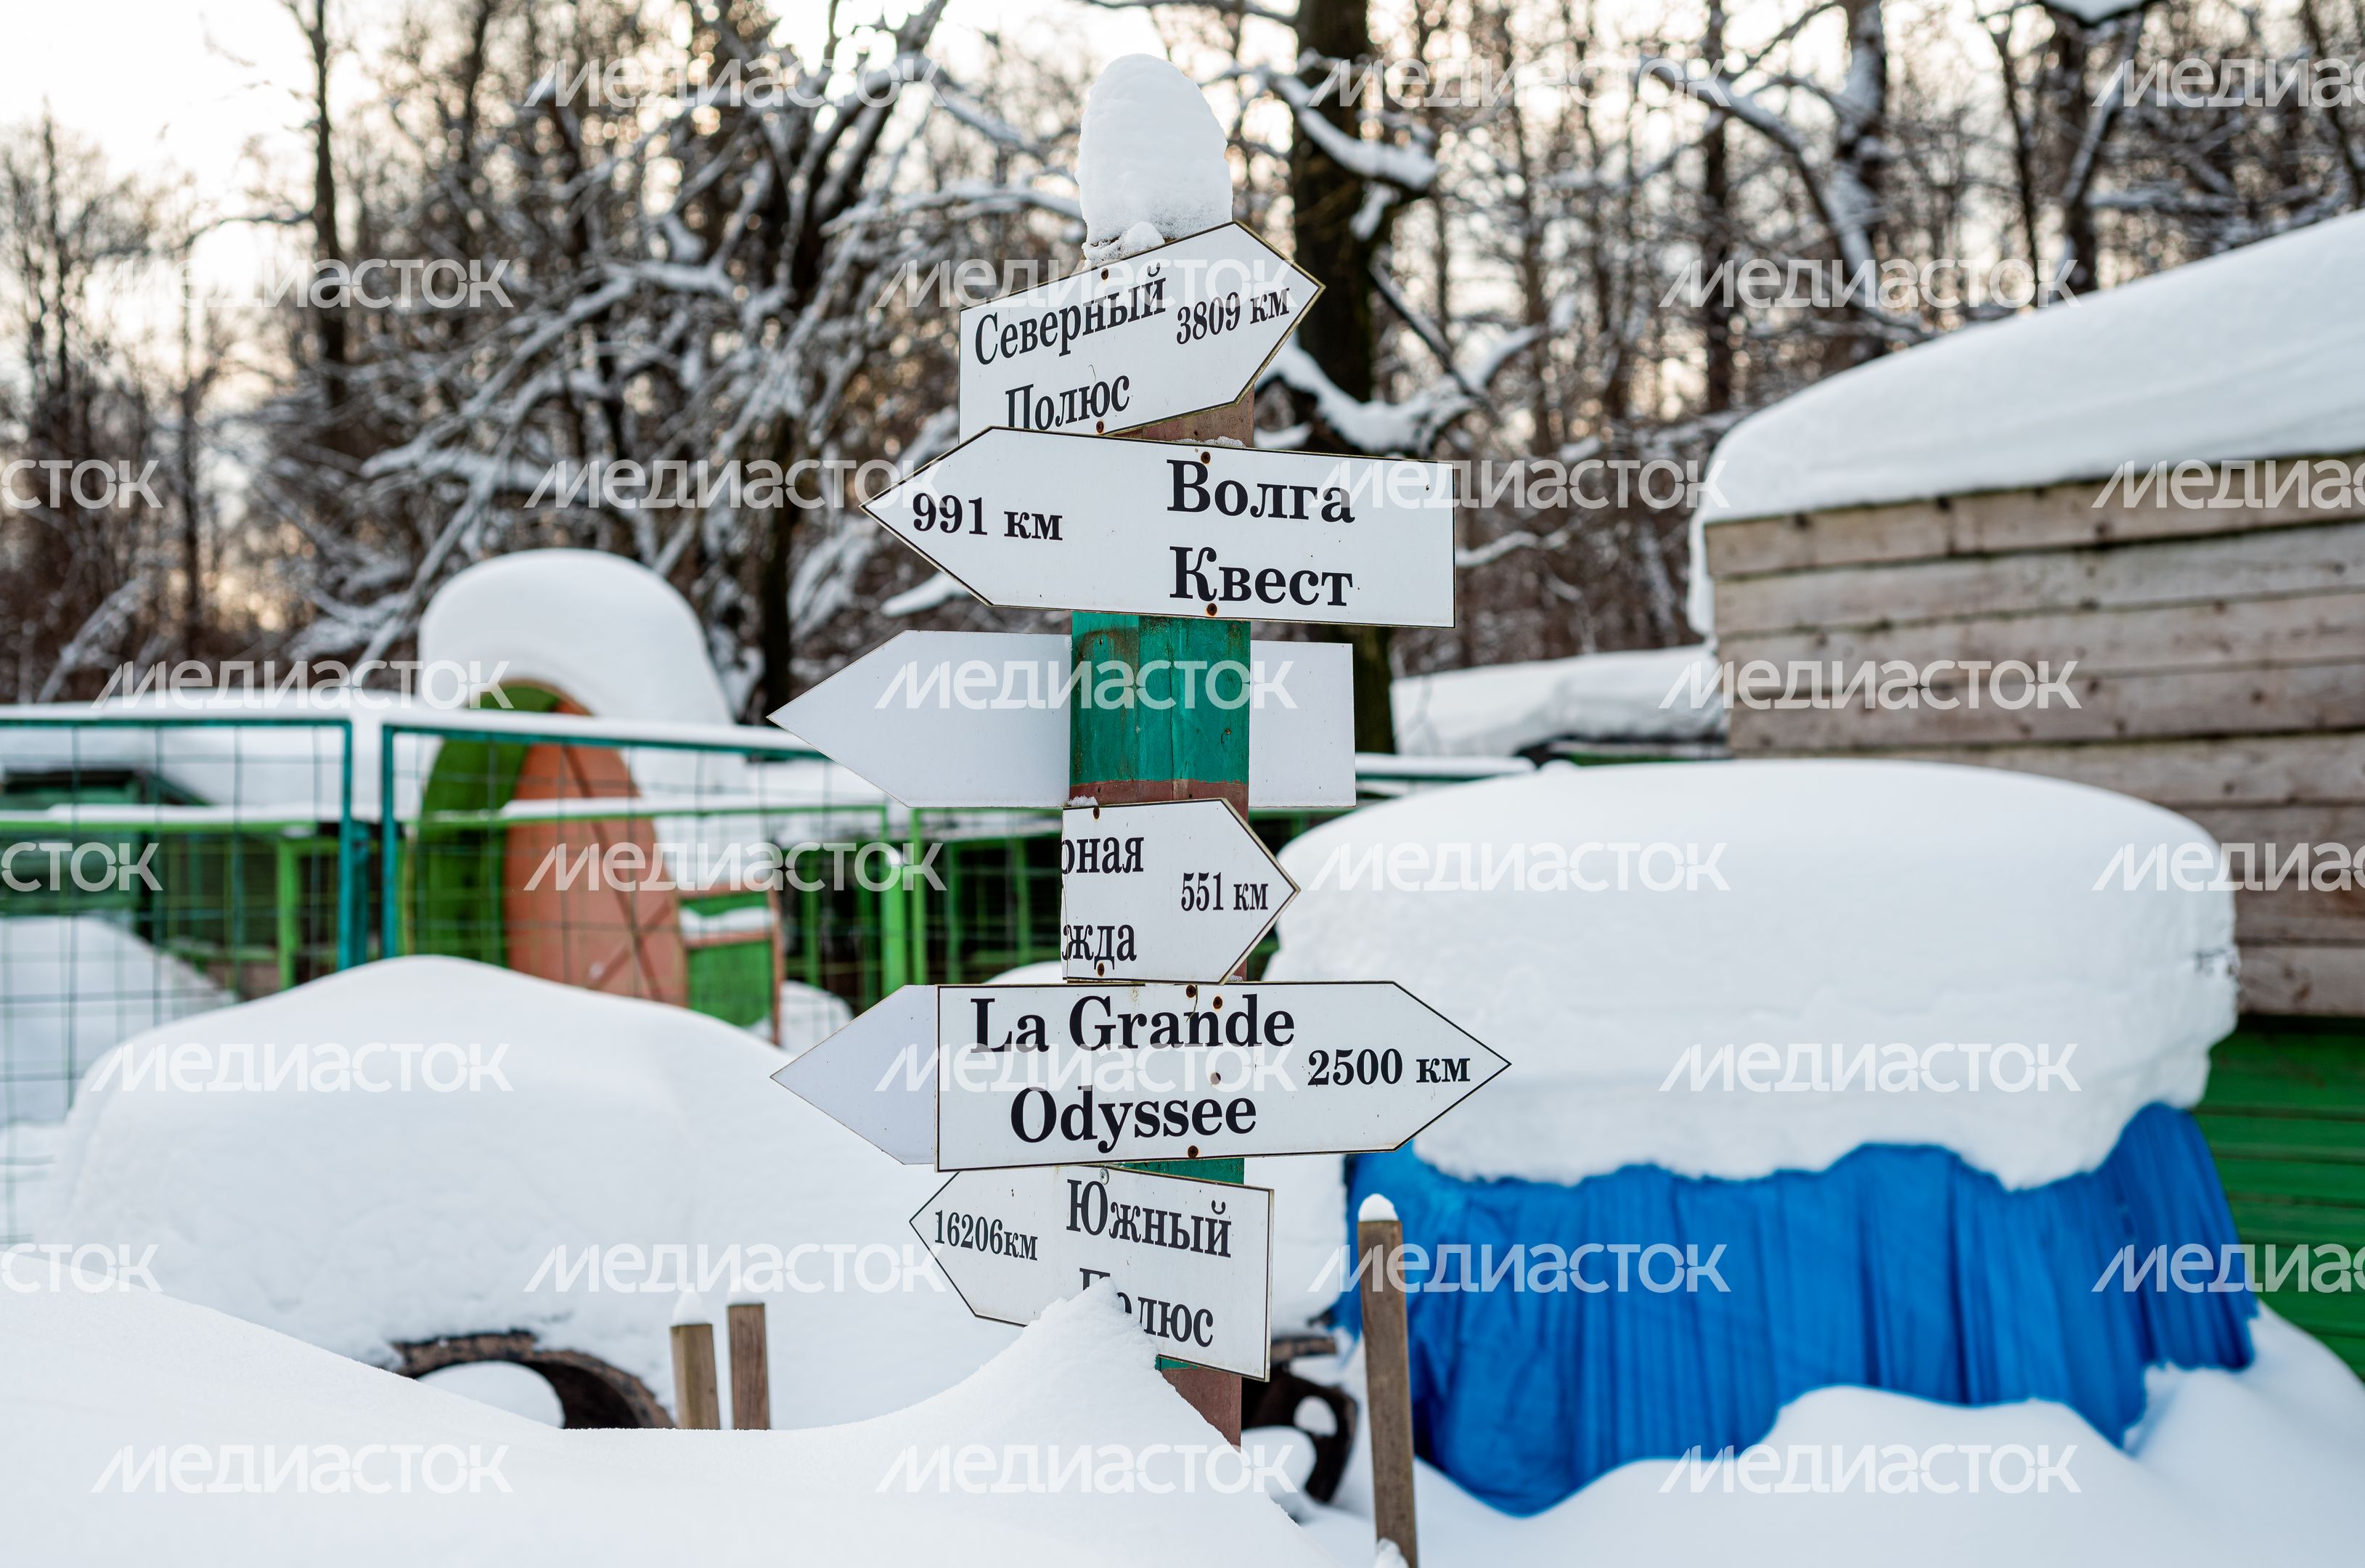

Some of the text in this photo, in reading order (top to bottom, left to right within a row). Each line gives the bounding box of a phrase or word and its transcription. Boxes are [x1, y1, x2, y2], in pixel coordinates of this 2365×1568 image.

[975, 262, 1167, 365] Северный
[1176, 291, 1290, 345] 3809 км
[1005, 375, 1130, 432] Полюс
[912, 492, 1063, 541] 991 км
[1166, 460, 1356, 523] Волга
[1169, 546, 1353, 607] Квест
[1180, 871, 1269, 912] 551 км
[970, 990, 1295, 1053] La Grande
[1307, 1048, 1471, 1087] 2500 км
[1010, 1085, 1257, 1154] Odyssee
[1066, 1179, 1232, 1258] Южный
